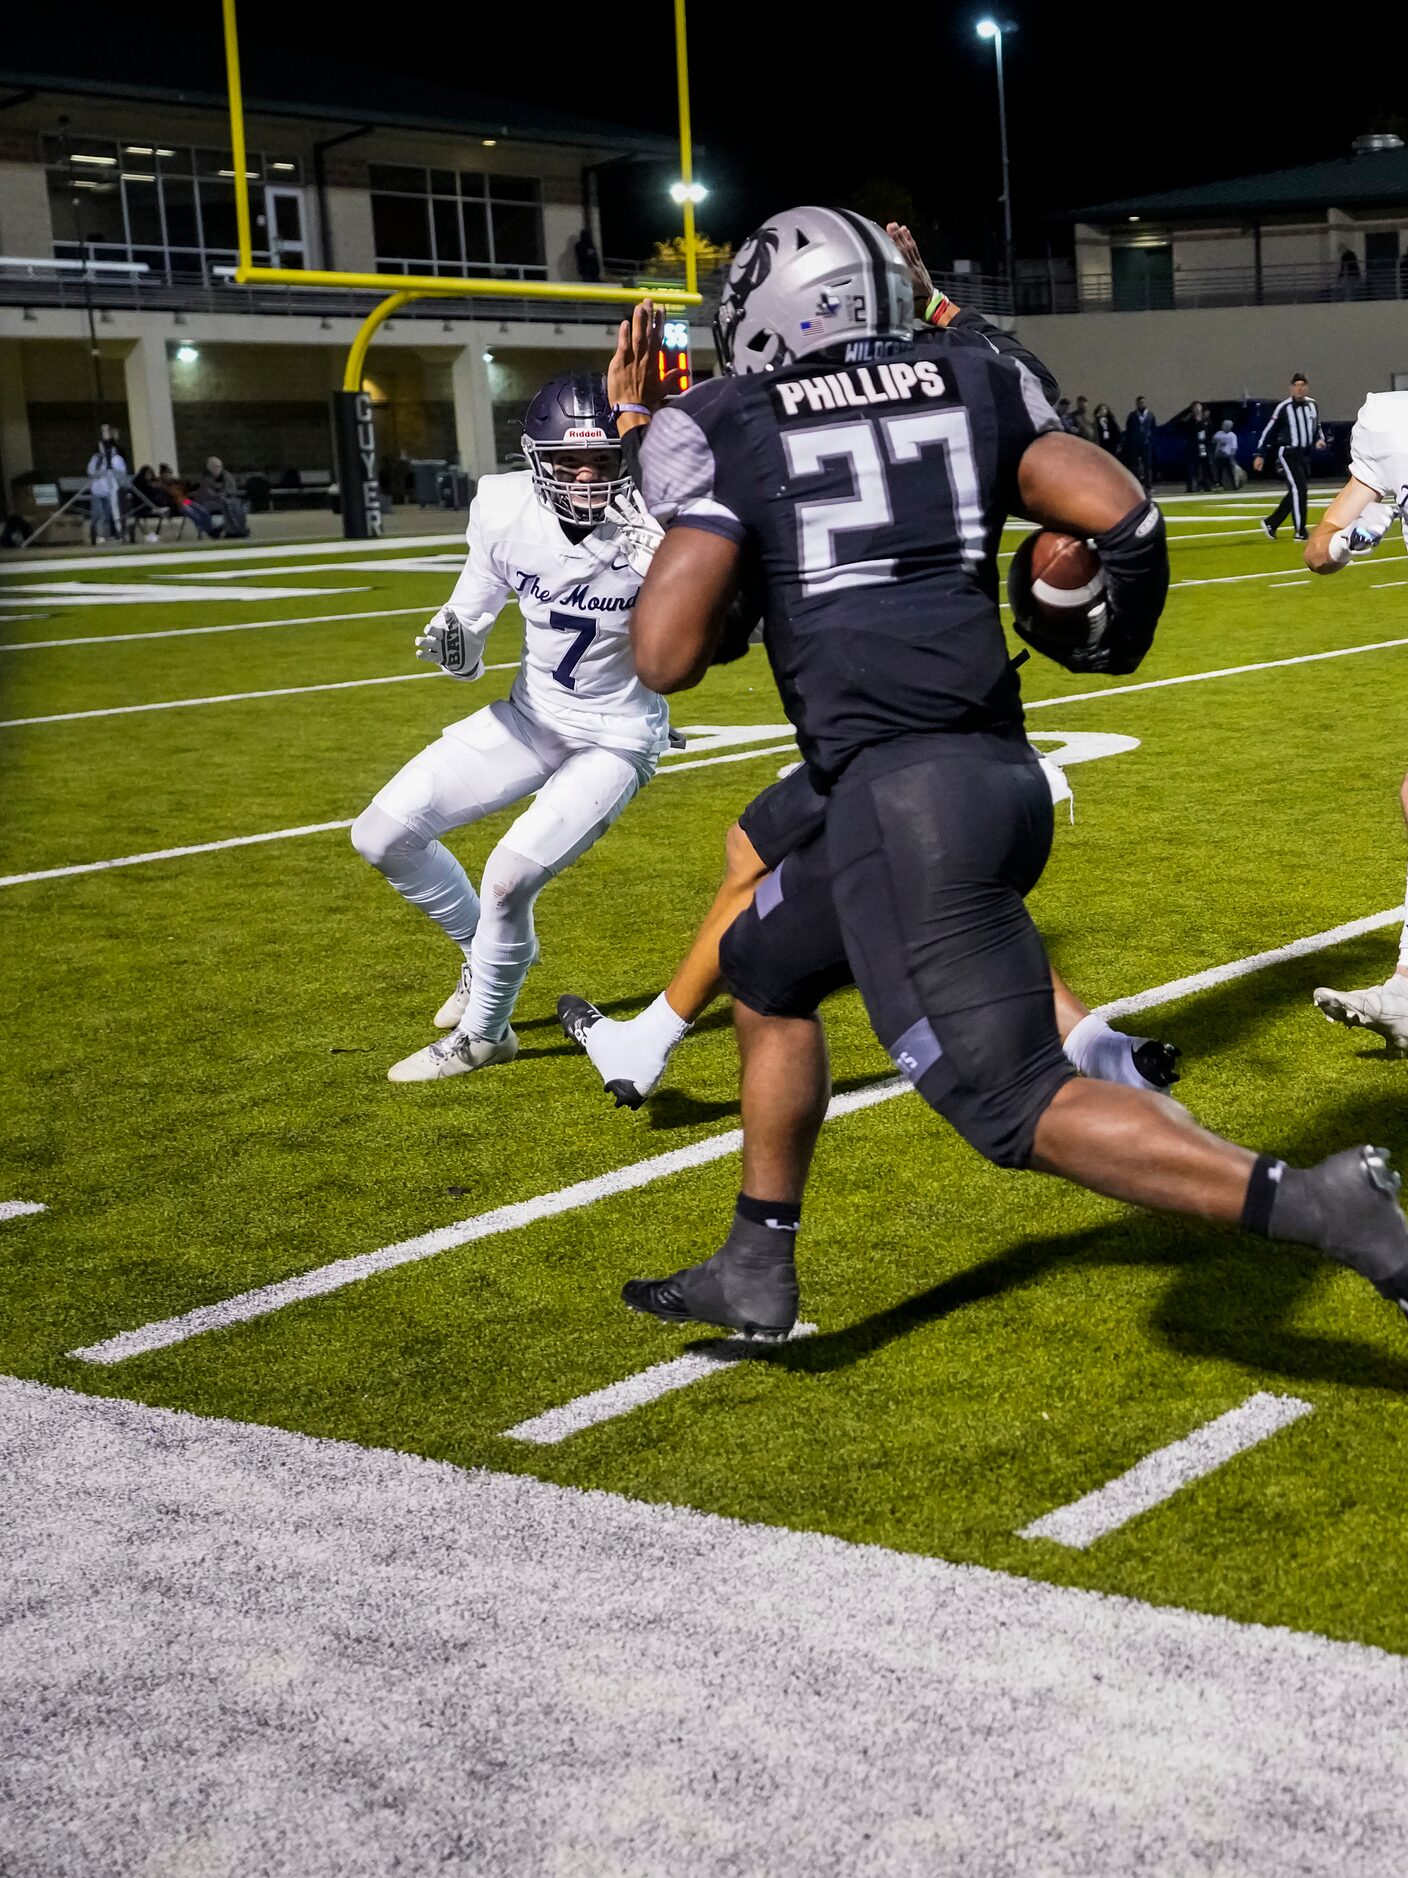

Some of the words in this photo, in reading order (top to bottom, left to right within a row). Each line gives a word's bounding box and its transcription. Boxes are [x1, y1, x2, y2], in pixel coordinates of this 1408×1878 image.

[776, 361, 945, 415] PHILLIPS
[355, 394, 383, 537] GUYER
[569, 430, 602, 438] Riddell
[781, 407, 987, 598] 27
[515, 571, 551, 602] The
[560, 583, 639, 612] Mound
[549, 610, 600, 692] 7
